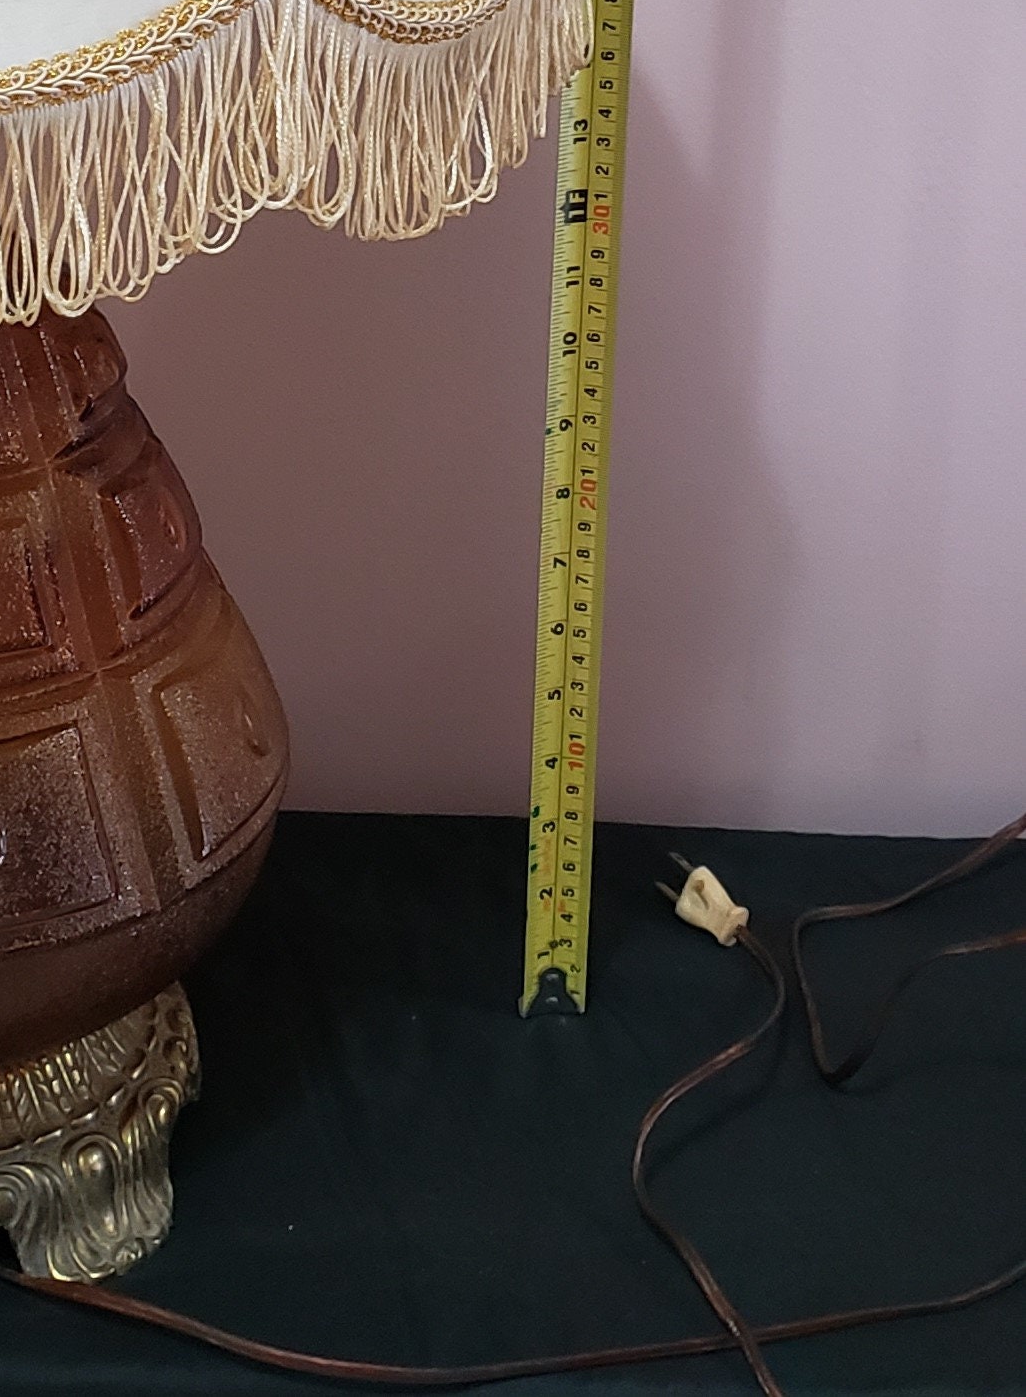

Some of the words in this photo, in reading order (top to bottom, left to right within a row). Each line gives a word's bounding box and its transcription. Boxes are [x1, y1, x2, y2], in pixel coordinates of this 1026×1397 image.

[603, 21, 616, 31] 7
[601, 51, 615, 61] 6
[600, 80, 613, 89] 5
[598, 109, 612, 118] 4
[573, 119, 588, 144] 13
[596, 138, 610, 147] 3
[595, 165, 609, 175] 2
[594, 193, 608, 201] 1
[592, 205, 610, 234] 30
[591, 250, 604, 259] 9
[566, 266, 580, 288] 11
[589, 278, 603, 287] 8
[588, 305, 602, 314] 7
[587, 333, 600, 342] 6
[562, 332, 577, 357] 10
[585, 361, 599, 370] 5
[584, 388, 598, 397] 4
[583, 415, 597, 424] 3
[559, 419, 573, 431] 9
[582, 442, 595, 452] 2
[580, 468, 593, 476] 1
[556, 488, 570, 499] 8
[579, 479, 596, 510] 20
[578, 523, 591, 532] 9
[577, 549, 590, 558] 8
[553, 557, 567, 568] 7
[575, 575, 589, 584] 7
[574, 602, 587, 612] 6
[551, 623, 564, 635] 6
[573, 629, 586, 638] 5
[572, 655, 585, 664] 4
[571, 682, 584, 691] 3
[548, 689, 561, 700] 5
[569, 708, 583, 717] 2
[568, 742, 585, 771] 10
[545, 757, 558, 769] 4
[566, 786, 579, 794] 9
[565, 812, 578, 821] 8
[542, 821, 555, 833] 3
[564, 838, 577, 846] 7
[562, 863, 576, 872] 6
[540, 887, 553, 900] 2
[562, 888, 575, 897] 5
[561, 914, 573, 923] 4
[558, 938, 572, 948] 3
[537, 951, 550, 960] 1
[570, 964, 581, 973] 2
